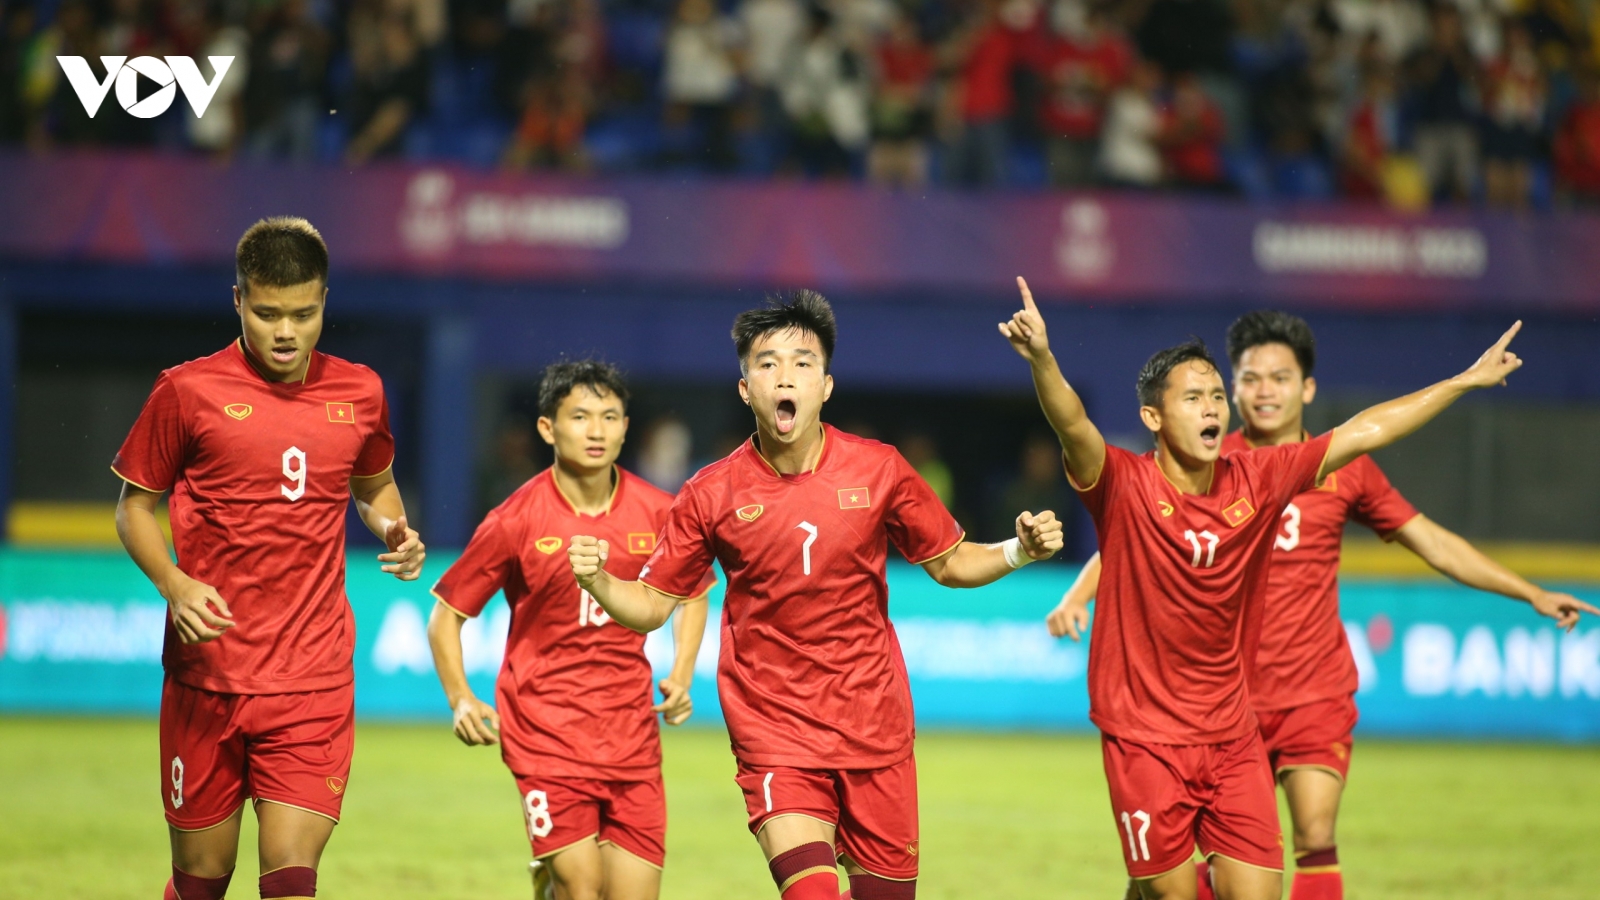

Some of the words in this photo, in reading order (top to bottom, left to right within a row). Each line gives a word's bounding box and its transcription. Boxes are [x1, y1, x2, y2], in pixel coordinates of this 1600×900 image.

[281, 446, 306, 501] 9
[794, 520, 818, 576] 7
[1184, 529, 1220, 568] 17
[1273, 502, 1301, 551] 3
[1403, 623, 1600, 697] BANK
[171, 756, 184, 809] 9
[1121, 809, 1151, 861] 17
